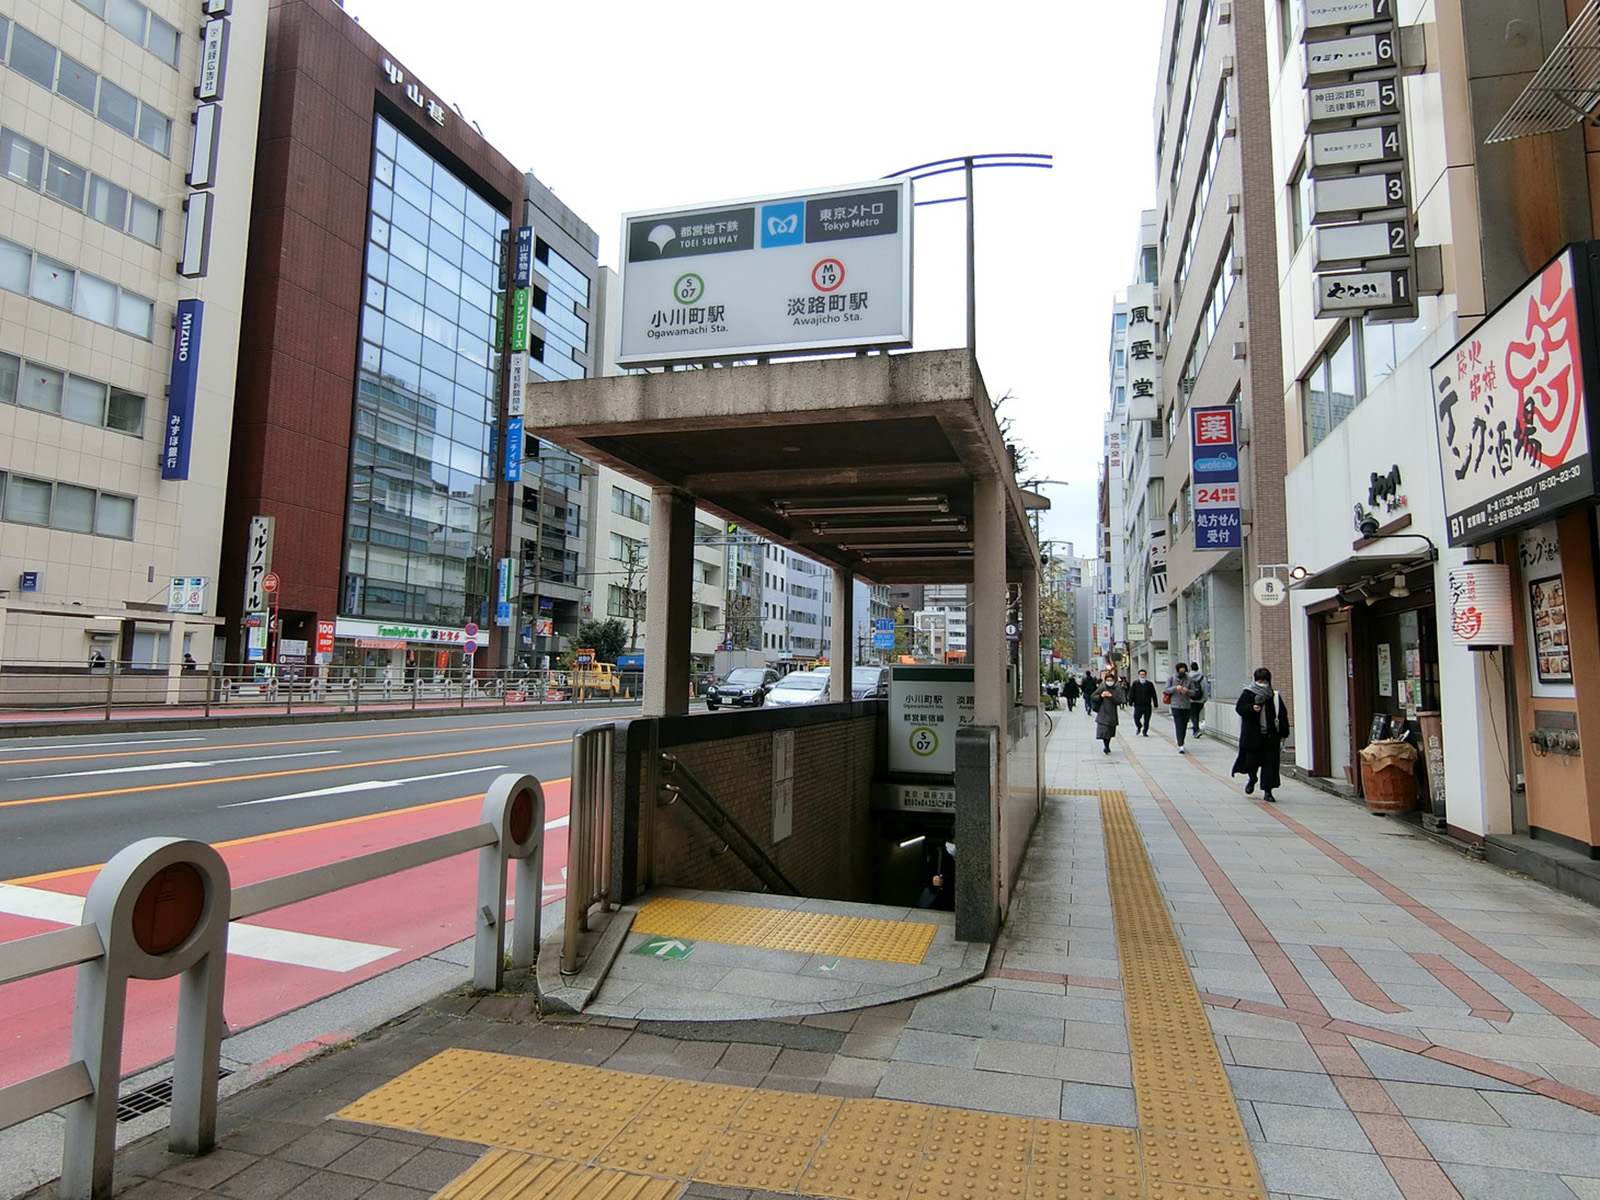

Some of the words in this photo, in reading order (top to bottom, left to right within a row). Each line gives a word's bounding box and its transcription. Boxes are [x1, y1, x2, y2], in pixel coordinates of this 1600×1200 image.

[1378, 40, 1391, 58] 6
[1314, 88, 1365, 102] 神田淡路町
[1382, 86, 1395, 106] 5
[1326, 98, 1376, 114] 法律事務所
[1384, 132, 1398, 152] 4
[1388, 179, 1402, 200] 3
[820, 203, 884, 220] 東京メトロ
[680, 220, 740, 237] 都営地下鉄
[823, 221, 850, 232] Tokyo
[852, 218, 880, 230] Metro
[680, 238, 700, 249] TOEI
[702, 234, 740, 247] SUBWAY
[1391, 228, 1404, 248] 2
[822, 264, 834, 274] M
[686, 278, 692, 288] S
[822, 274, 836, 286] 19
[1397, 276, 1404, 297] 1
[681, 288, 696, 299] 07
[787, 292, 868, 316] 淡路町駅
[651, 305, 725, 328] 小川町駅
[792, 314, 840, 326] Awajicho
[843, 312, 863, 322] Sta.
[179, 312, 192, 362] MIZUHO
[647, 325, 708, 340] Ogawamachi
[710, 324, 729, 334] Sta.
[1128, 306, 1154, 399] 風雲堂
[1200, 416, 1228, 440] 薬
[1438, 376, 1542, 482] テング酒場
[167, 415, 180, 468] みずほ銀行
[1198, 458, 1232, 470] welcia
[1198, 489, 1221, 503] 24
[1198, 514, 1238, 527] 処方せん
[1451, 516, 1464, 538] B1
[1207, 529, 1230, 543] 受付
[248, 535, 267, 609] ルノアール
[319, 624, 334, 634] 100
[378, 625, 419, 638] FamilyMart
[905, 694, 943, 704] 小川町駅
[904, 714, 944, 722] 都営新宿線
[921, 732, 926, 740] S
[916, 741, 931, 750] 07
